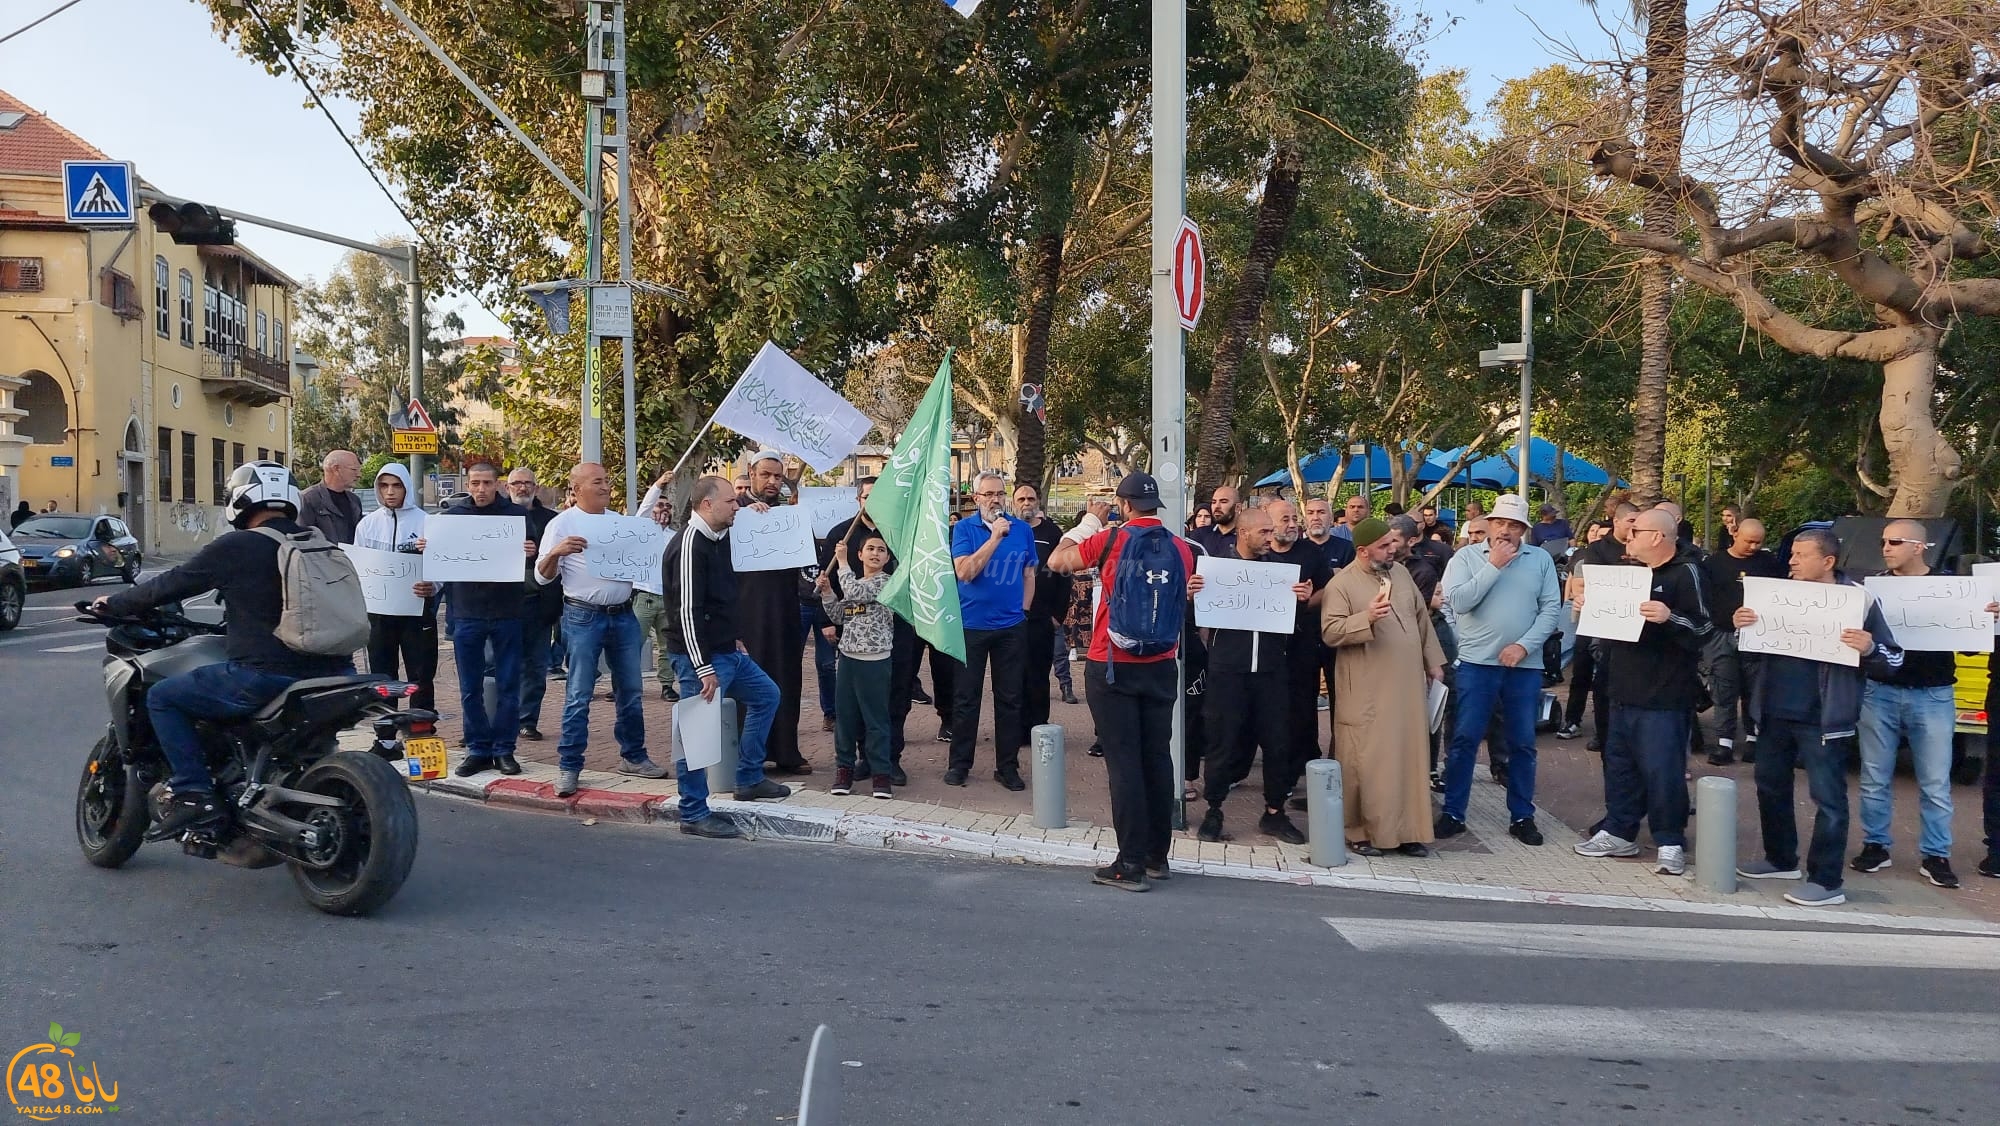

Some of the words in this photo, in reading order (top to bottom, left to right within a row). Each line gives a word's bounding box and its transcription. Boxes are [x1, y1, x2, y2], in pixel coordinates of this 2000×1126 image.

[591, 347, 600, 407] 10069
[404, 435, 427, 443] האט!
[395, 443, 413, 451] בדרך
